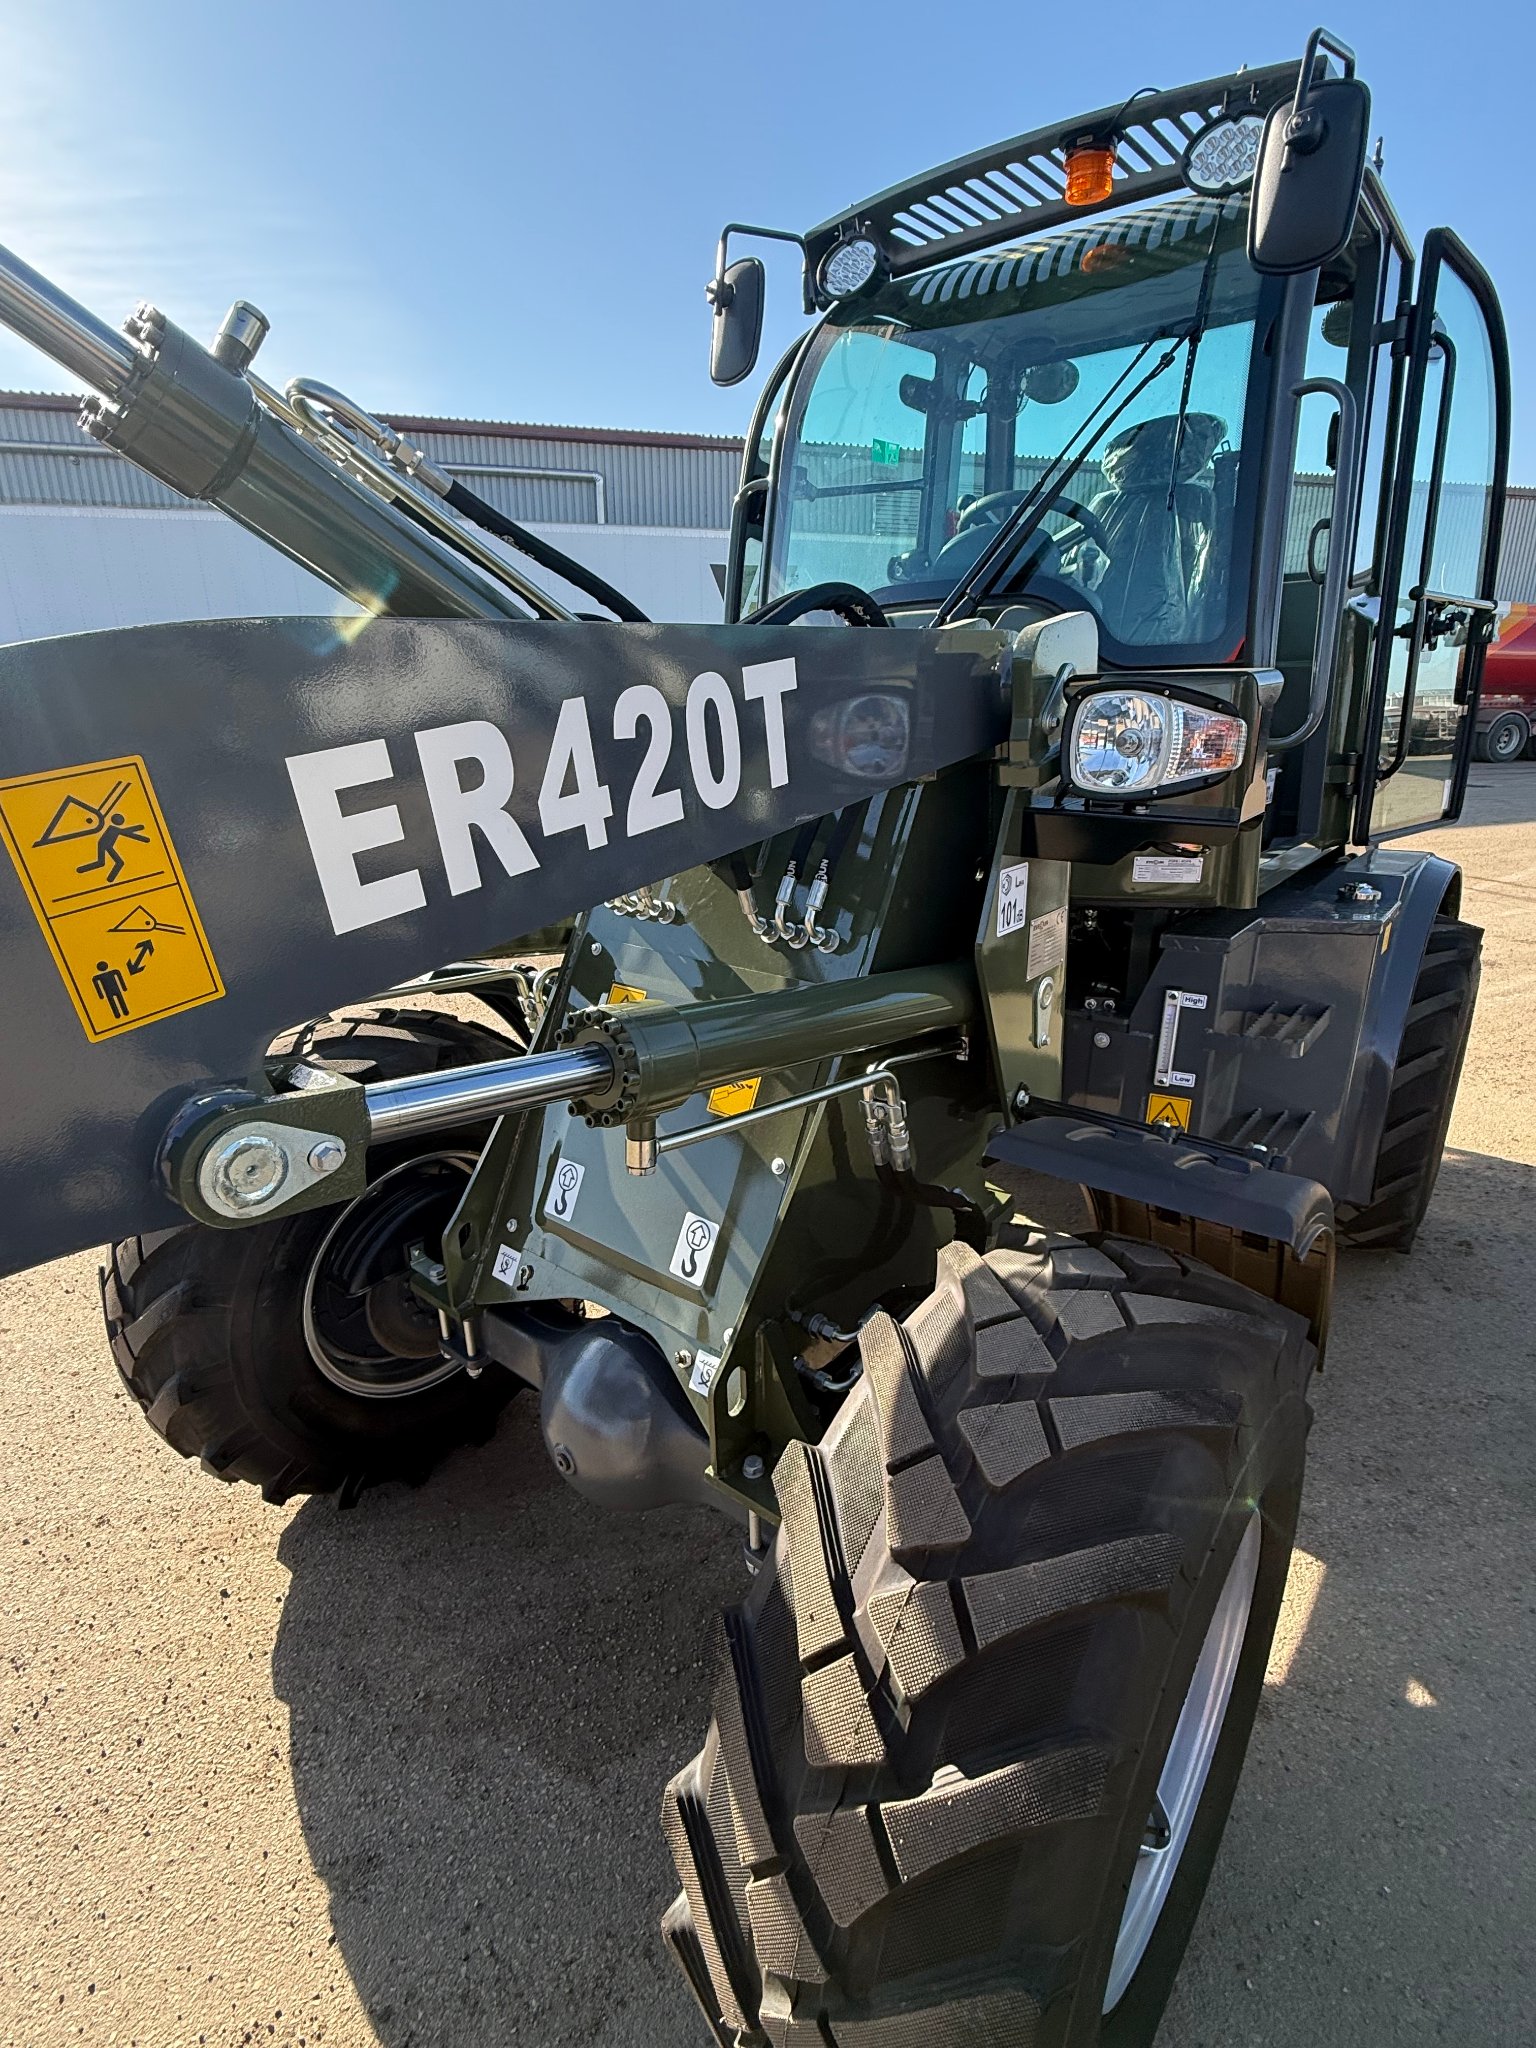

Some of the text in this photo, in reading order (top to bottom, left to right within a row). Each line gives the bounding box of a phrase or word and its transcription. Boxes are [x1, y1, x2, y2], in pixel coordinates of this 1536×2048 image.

[285, 657, 797, 935] ER420T
[1184, 996, 1203, 1005] High
[1174, 1075, 1191, 1083] Low
